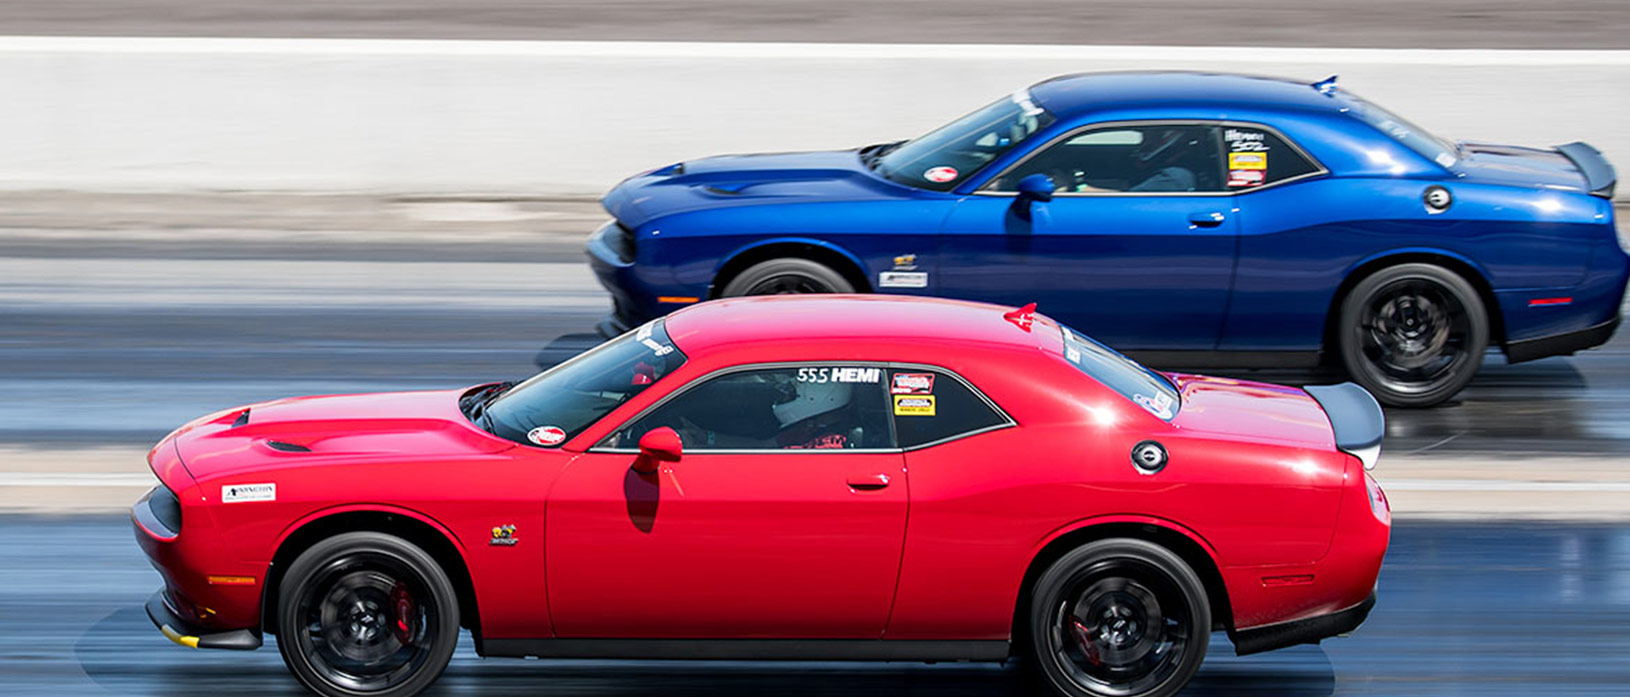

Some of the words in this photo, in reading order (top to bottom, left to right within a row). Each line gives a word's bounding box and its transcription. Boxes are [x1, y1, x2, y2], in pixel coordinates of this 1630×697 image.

[1231, 140, 1271, 151] 502
[797, 367, 829, 383] 555
[831, 368, 880, 383] HEMI
